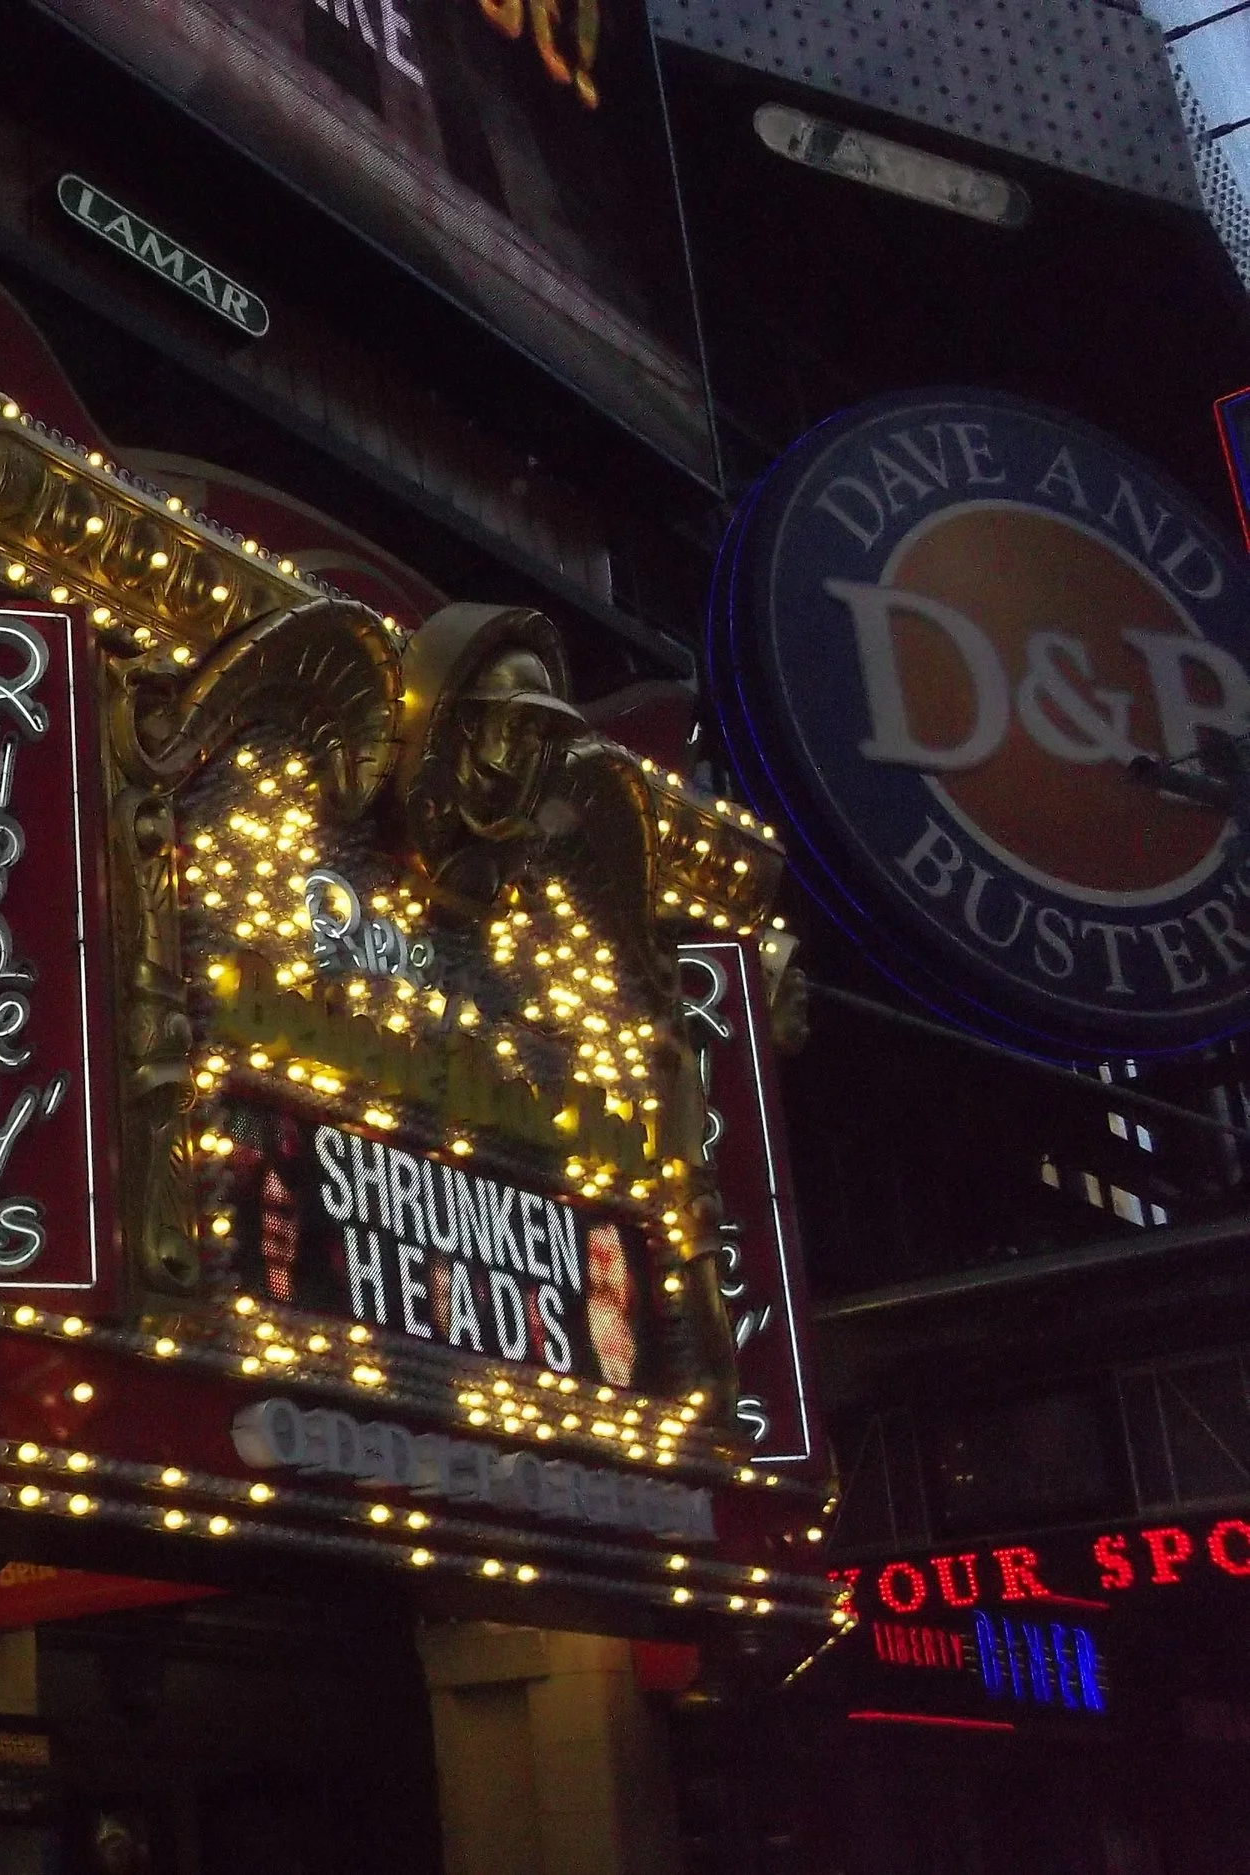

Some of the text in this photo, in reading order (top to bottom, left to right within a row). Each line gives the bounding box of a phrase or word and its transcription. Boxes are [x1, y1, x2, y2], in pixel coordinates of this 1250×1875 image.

[76, 187, 251, 326] LAMAR
[818, 423, 1225, 600] DAVE AND
[896, 817, 1250, 996] BUSTER'
[314, 1124, 585, 1291] SHRUNKEN
[344, 1226, 575, 1375] HEADS
[828, 1545, 1050, 1622] YOUR
